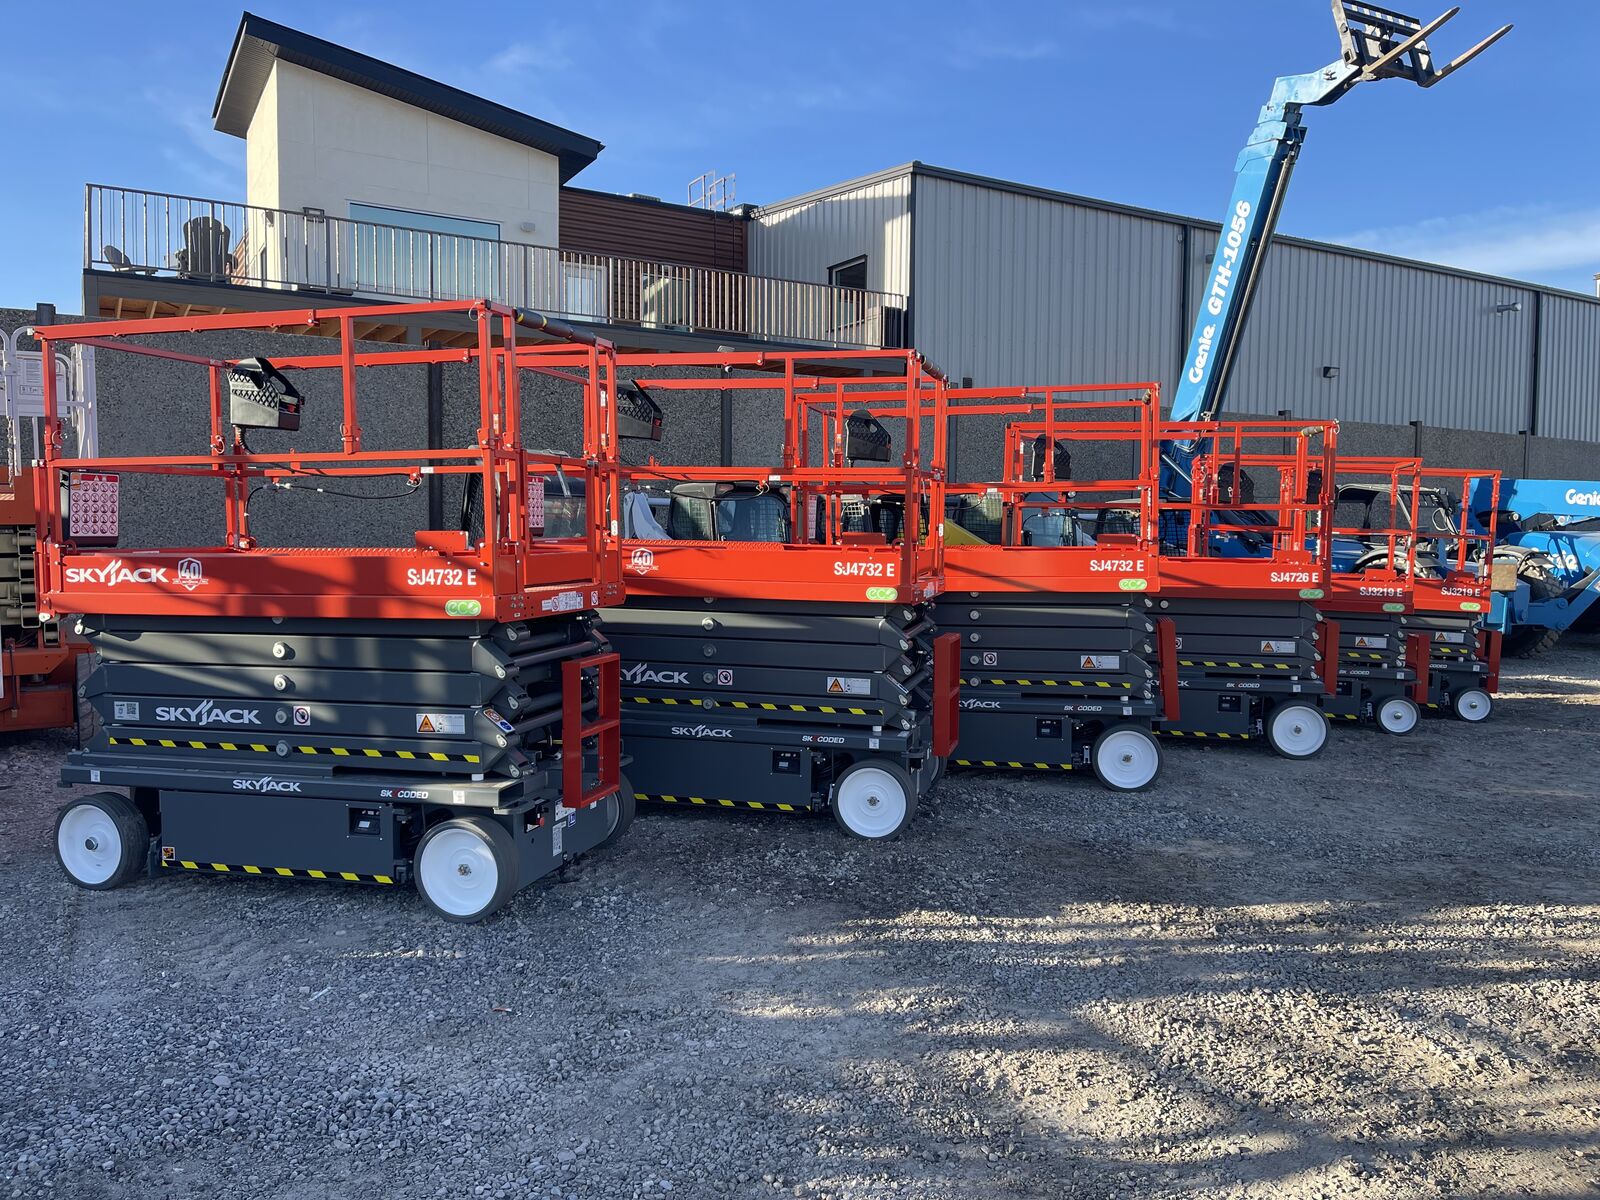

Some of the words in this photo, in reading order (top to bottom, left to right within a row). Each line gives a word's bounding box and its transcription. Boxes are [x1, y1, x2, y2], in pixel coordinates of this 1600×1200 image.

[1207, 200, 1251, 316] GTH-1056
[1188, 323, 1217, 384] Genie
[634, 551, 651, 566] 40
[1089, 559, 1134, 571] SJ4732
[1136, 560, 1145, 572] E
[65, 559, 169, 587] SKYJACK
[181, 561, 199, 579] 40
[407, 568, 463, 585] SJ4732
[467, 569, 477, 585] E
[834, 561, 883, 576] SJ4732
[886, 563, 895, 577] E
[1270, 572, 1310, 582] SJ4726
[1312, 573, 1319, 583] E
[1359, 586, 1395, 596] SJ3219
[1396, 588, 1403, 597] E
[1441, 587, 1473, 597] SJ3219
[1474, 588, 1481, 597] E
[619, 662, 690, 684] YJACK
[155, 699, 262, 726] SKYJACK
[671, 724, 733, 738] SKYJACK
[232, 776, 302, 793] SKYJACK
